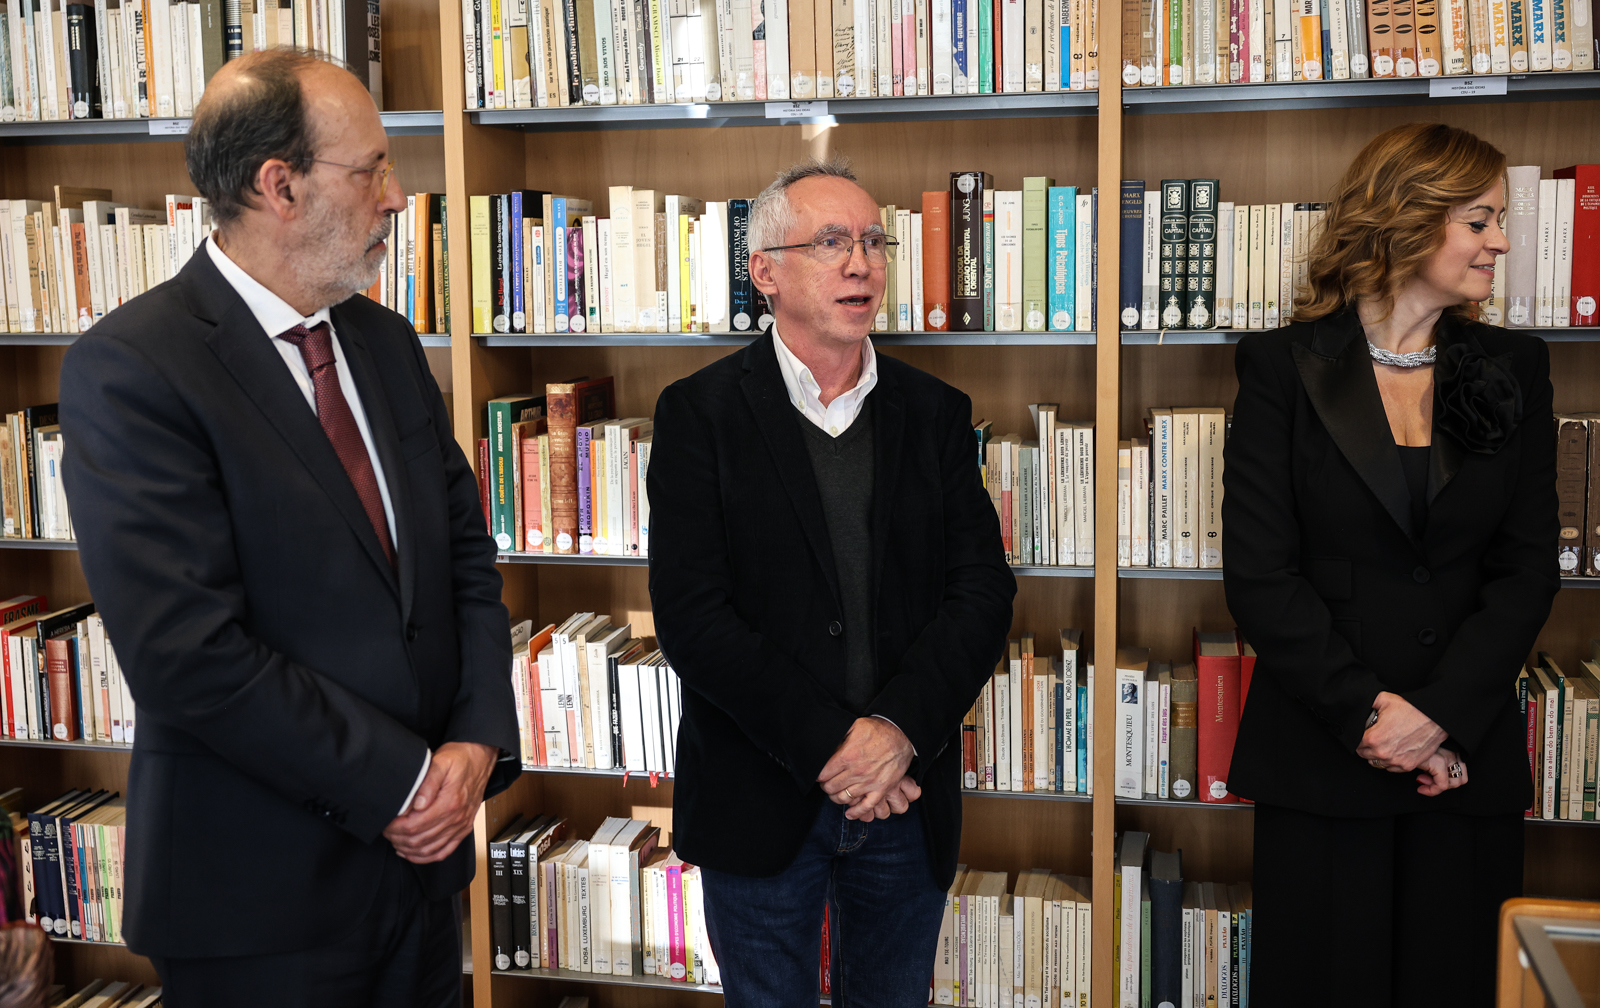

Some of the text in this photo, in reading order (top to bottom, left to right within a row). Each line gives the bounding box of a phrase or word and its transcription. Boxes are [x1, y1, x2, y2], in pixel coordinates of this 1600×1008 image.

[1372, 24, 1391, 34] O
[1394, 24, 1413, 34] O
[1418, 24, 1436, 34] O
[1492, 2, 1506, 47] MARX
[1510, 0, 1522, 46] MARX
[1532, 0, 1544, 44] MARX
[1554, 0, 1566, 43] MARX
[1202, 20, 1210, 54] ESTUDOS
[466, 34, 475, 73] GANDHI
[569, 32, 580, 74] problème
[572, 76, 579, 85] le
[734, 216, 740, 227] OF
[962, 198, 970, 222] JUNG
[958, 246, 964, 255] DA
[1054, 229, 1068, 294] Tipos Psicológicos
[962, 266, 970, 296] RELIGIÃO
[578, 462, 583, 470] EL
[4, 602, 40, 625] ERASME
[1215, 675, 1225, 722] Montesquieu
[1066, 718, 1072, 726] EN
[1547, 711, 1554, 719] do
[1125, 714, 1133, 767] MONTESQUIEU
[1546, 740, 1553, 748] do
